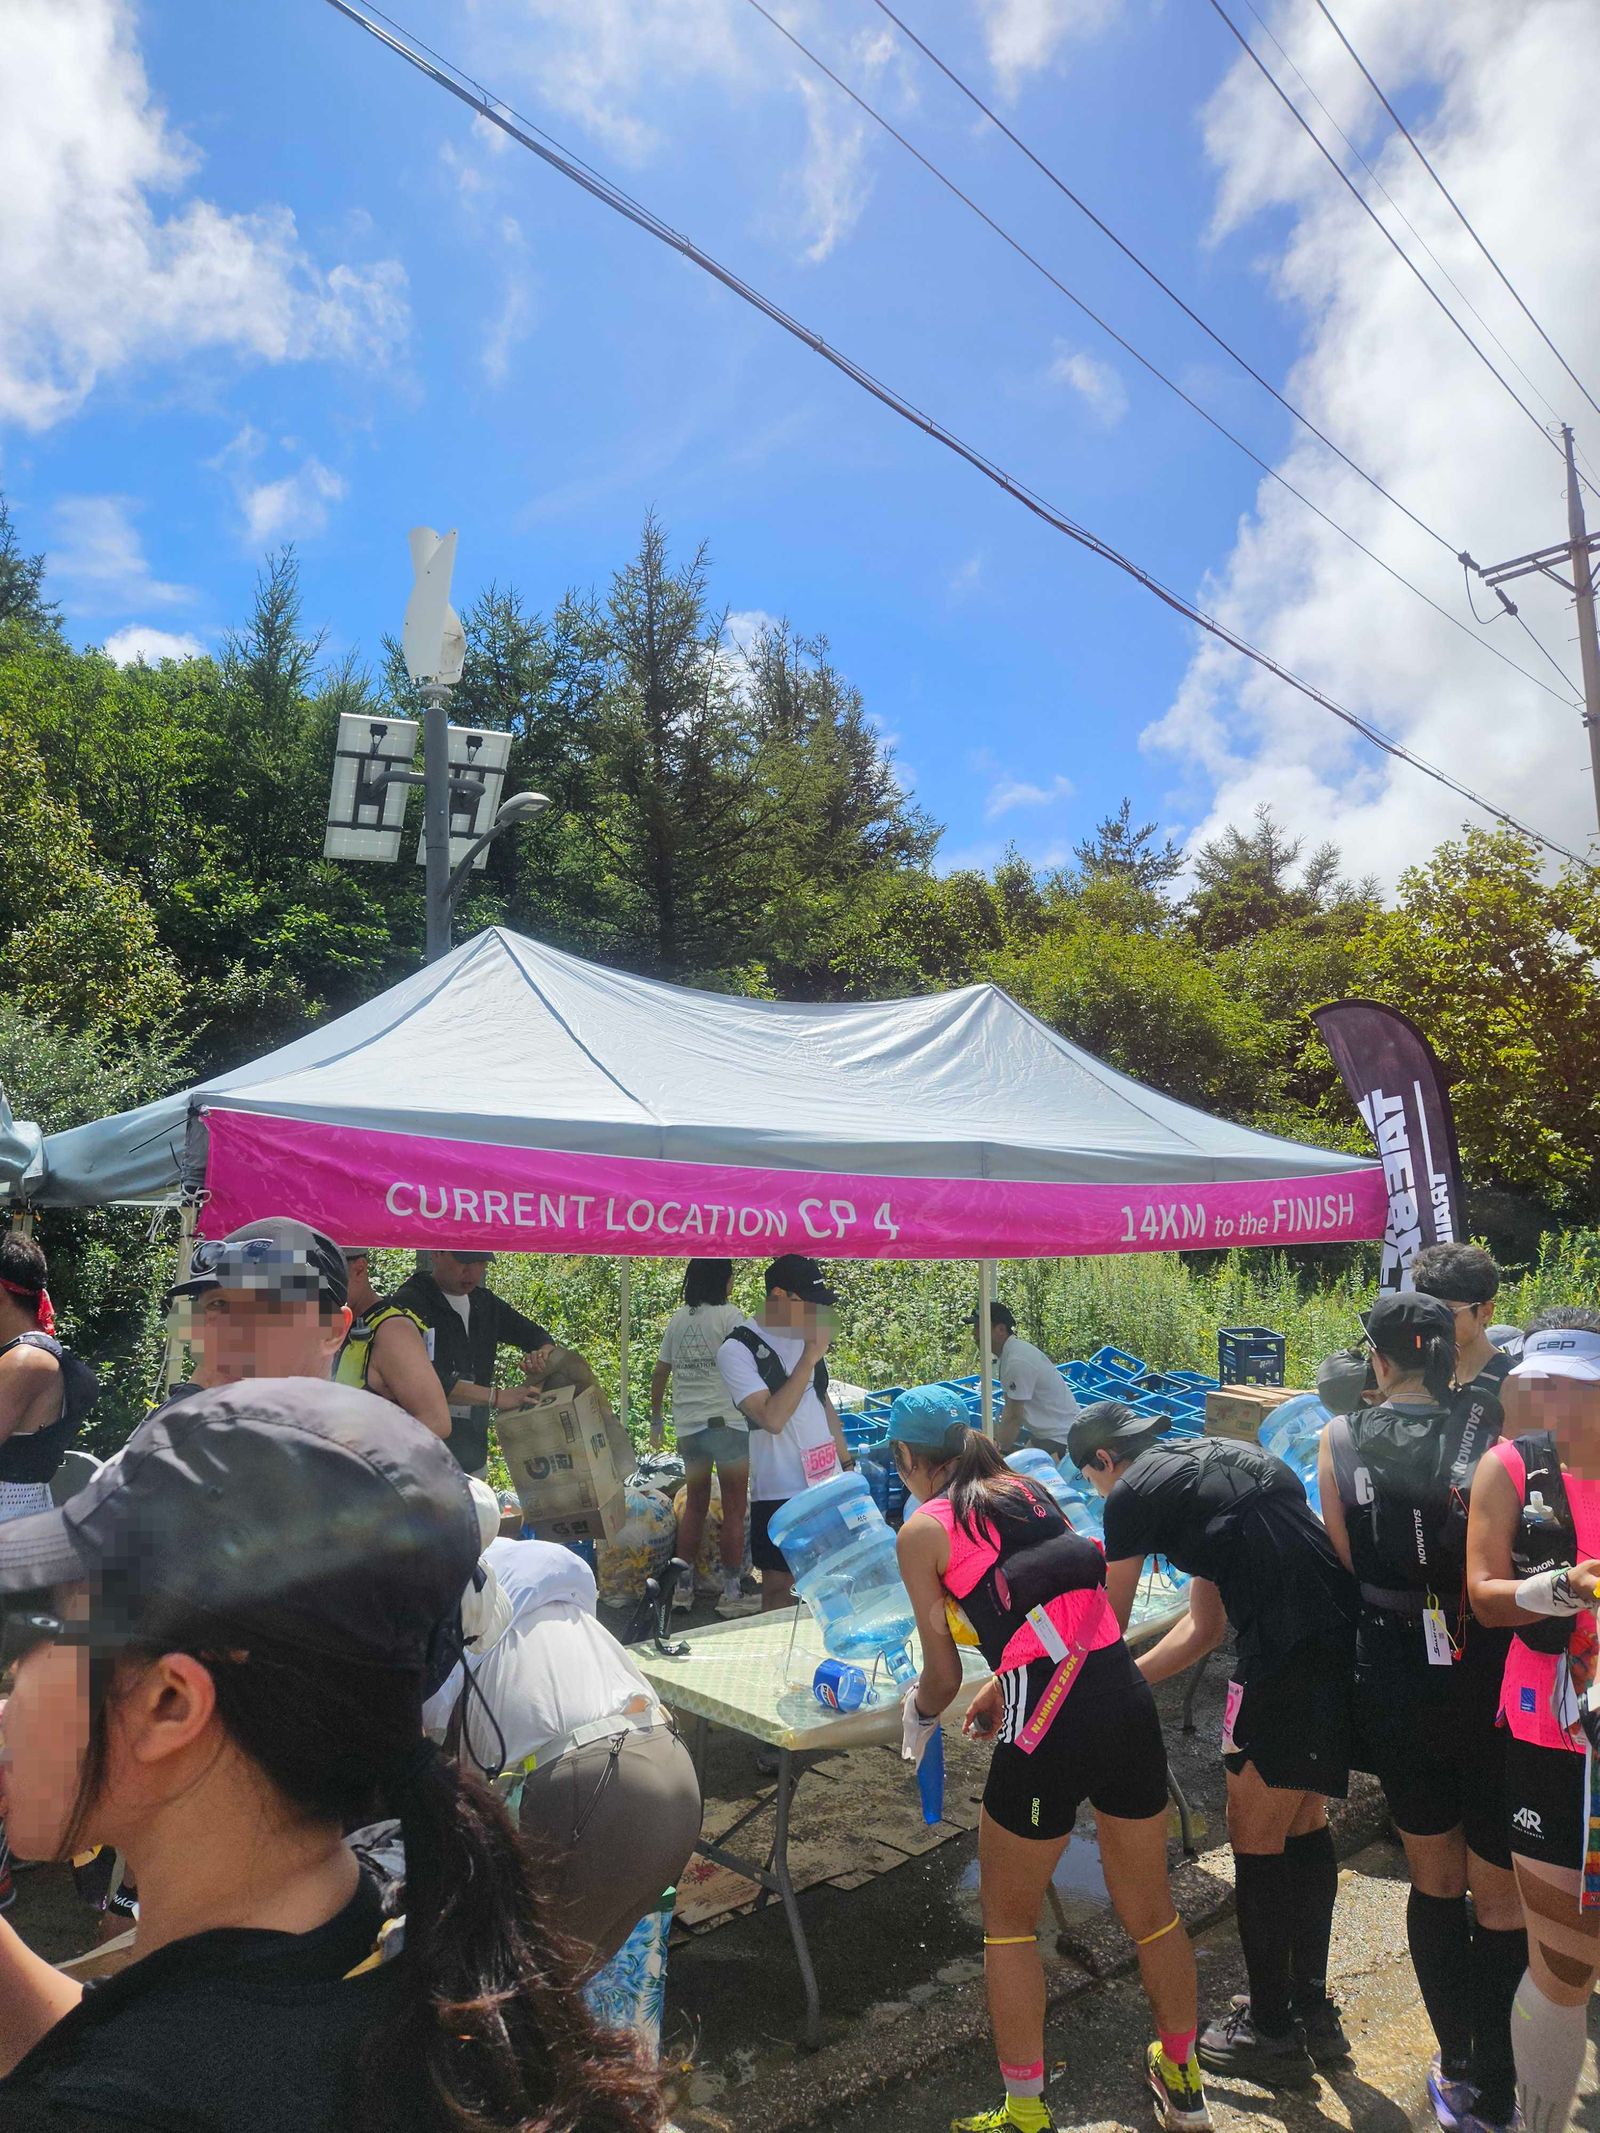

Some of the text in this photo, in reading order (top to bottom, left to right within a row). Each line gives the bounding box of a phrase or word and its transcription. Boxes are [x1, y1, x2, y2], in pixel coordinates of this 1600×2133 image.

[385, 1182, 899, 1240] CURRENT LOCATION CP 4
[1120, 1193, 1354, 1242] 14KM to the FINISH
[1450, 1403, 1484, 1475] SALOMON
[1413, 1508, 1428, 1565] SALOMON
[1517, 1557, 1556, 1574] OMON
[1059, 1654, 1078, 1685] 250K
[1513, 1807, 1542, 1833] AR
